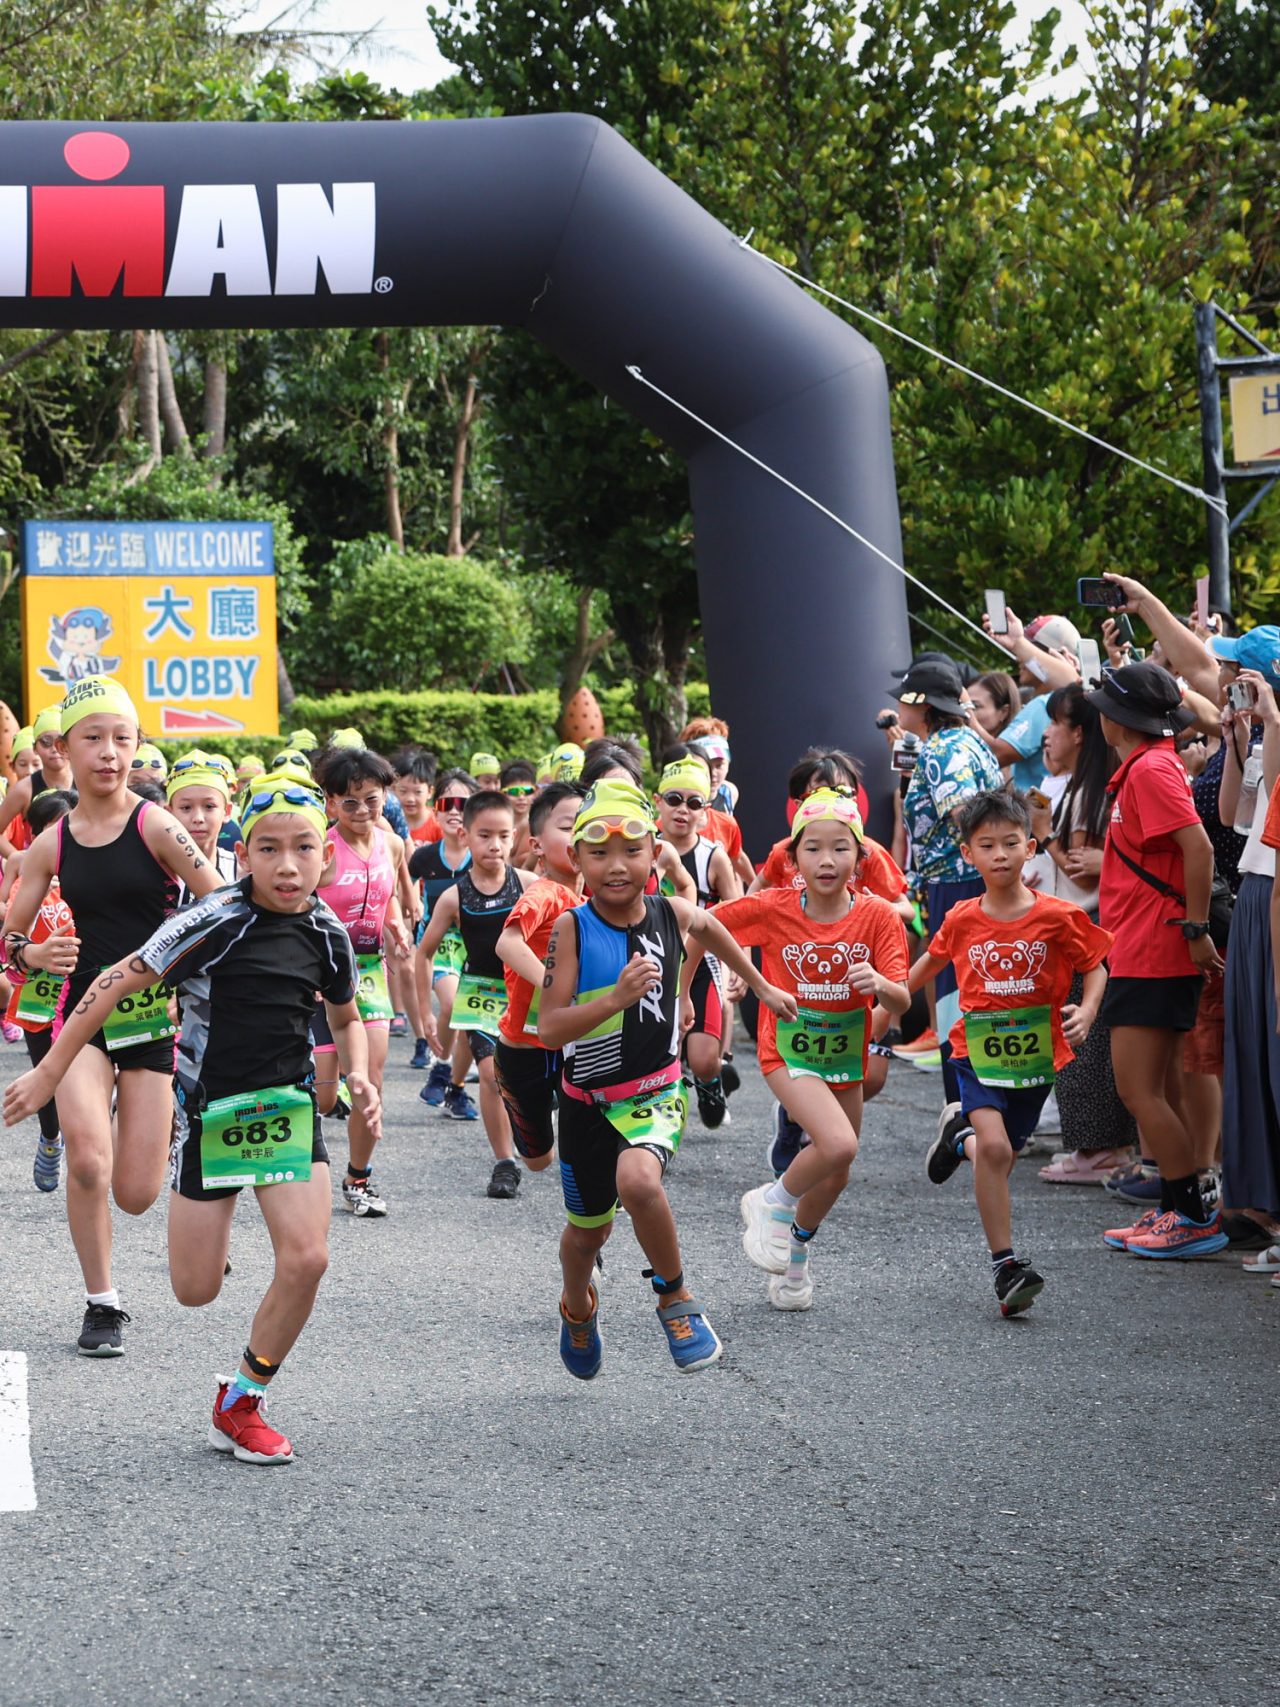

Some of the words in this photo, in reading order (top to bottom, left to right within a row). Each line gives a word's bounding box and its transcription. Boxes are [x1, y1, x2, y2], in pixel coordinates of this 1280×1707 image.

[37, 530, 146, 568] 歡迎光臨
[154, 531, 264, 567] WELCOME
[144, 585, 258, 642] 大廳
[144, 655, 259, 698] LOBBY
[35, 980, 64, 999] 65
[467, 996, 509, 1016] 667
[791, 1033, 849, 1055] 613
[984, 1033, 1040, 1057] 662
[222, 1116, 292, 1146] 683
